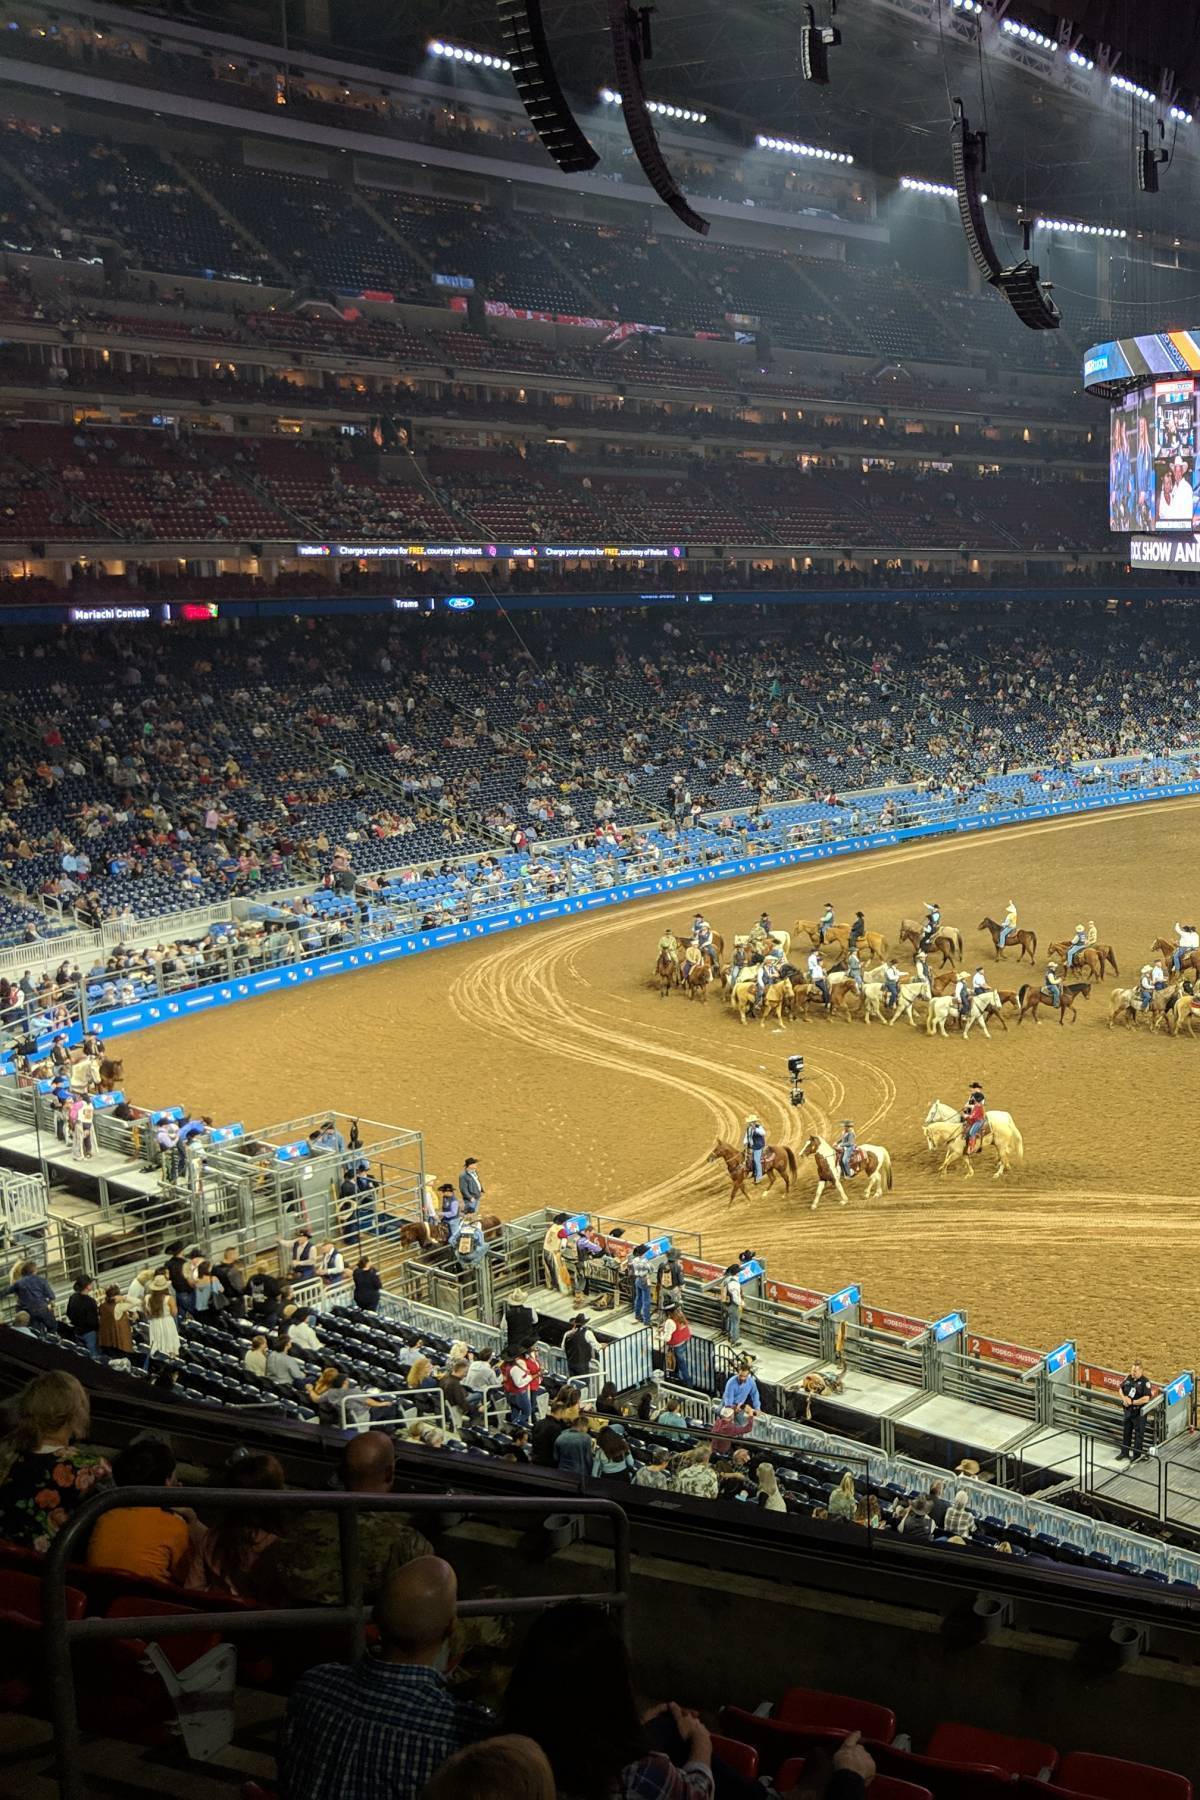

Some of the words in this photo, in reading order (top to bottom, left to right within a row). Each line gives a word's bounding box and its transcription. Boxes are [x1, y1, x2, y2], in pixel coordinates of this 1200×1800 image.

[340, 546, 363, 556] Charge
[364, 548, 378, 556] your
[379, 547, 399, 556] phone
[427, 547, 453, 556] courtesy
[1142, 542, 1172, 561] SHOW
[396, 600, 419, 608] Trams
[75, 608, 114, 620] Mariachi
[115, 607, 150, 619] Contest
[769, 1285, 777, 1297] 4
[865, 1311, 873, 1323] 3
[972, 1339, 981, 1353] 2
[1084, 1368, 1090, 1381] 1
